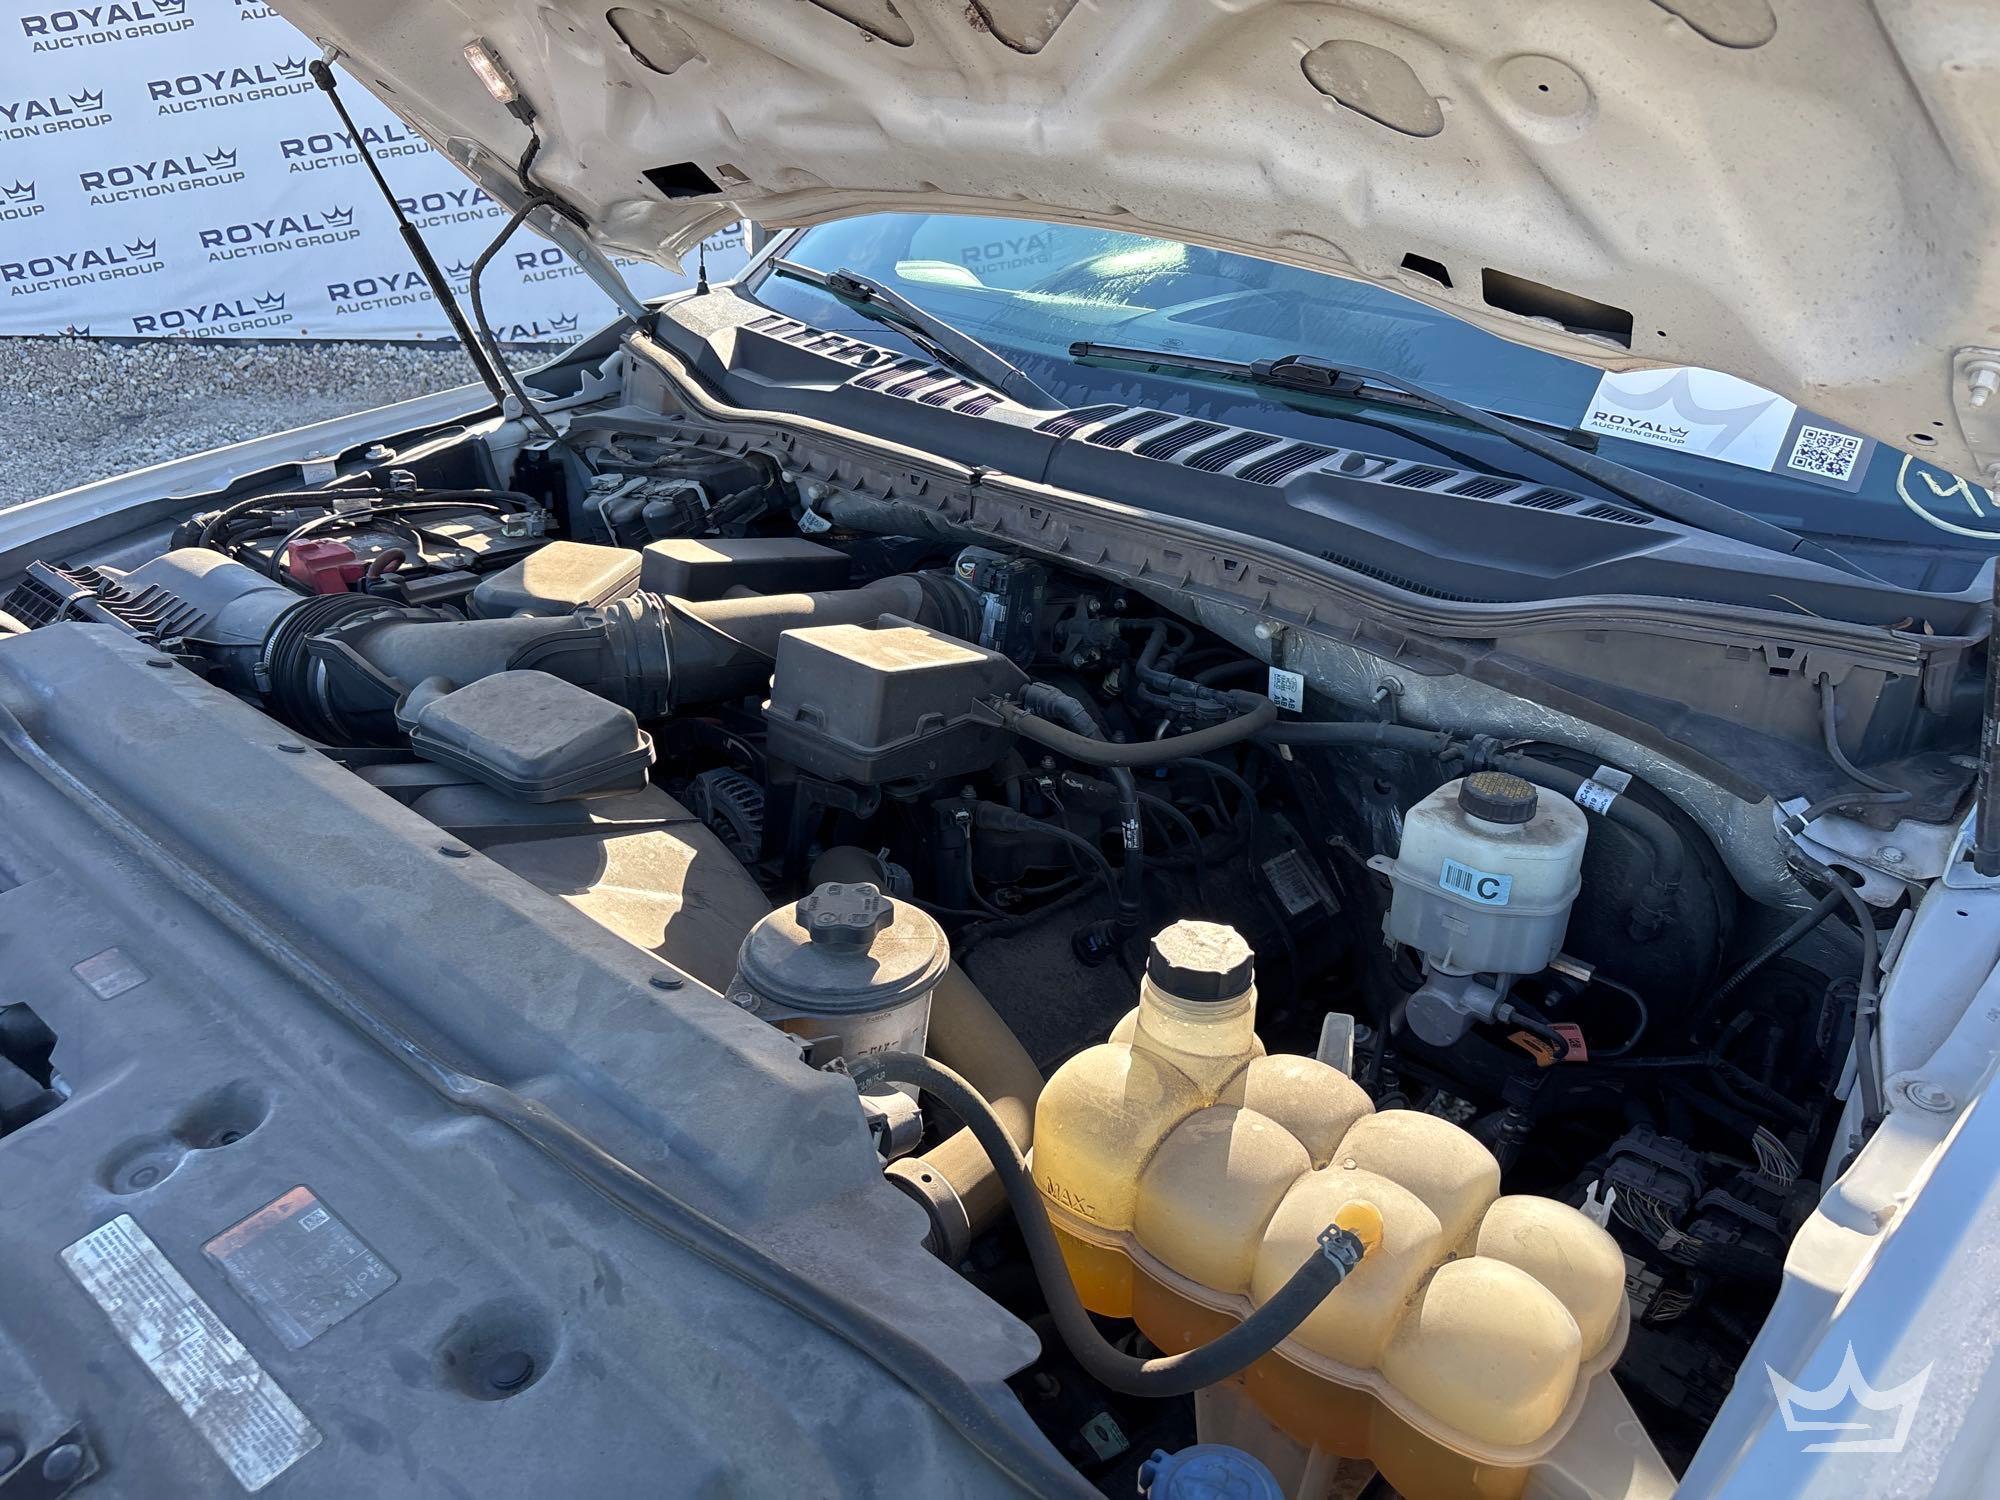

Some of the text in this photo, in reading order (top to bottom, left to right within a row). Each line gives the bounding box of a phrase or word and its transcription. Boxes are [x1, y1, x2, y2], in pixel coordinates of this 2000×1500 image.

[20, 1, 155, 37] ROYAL
[33, 18, 195, 53] AUCTION GROUP
[147, 65, 277, 101] ROYAL
[0, 98, 73, 123] YAL
[157, 81, 315, 116] AUCTION GROUP
[43, 114, 112, 134] GROUP
[377, 143, 436, 160] GROU
[79, 156, 207, 192] ROYAL
[90, 171, 246, 206] AUCTION GROUP
[397, 187, 495, 215] ROYA
[198, 214, 324, 249] ROYAL
[415, 209, 484, 229] UCTION
[208, 229, 361, 263] AUCTION GROUP
[0, 247, 127, 282] ROYAL
[11, 261, 165, 296] AUCTION GROUP
[523, 265, 585, 284] AUCTIO
[327, 271, 427, 301] ROYA
[132, 300, 256, 334] ROYAL
[335, 294, 415, 315] AUCTION
[228, 313, 293, 333] GROUP
[1590, 420, 1685, 445] AUCTION GROUP
[1593, 411, 1667, 434] ROYAL
[1477, 877, 1500, 900] C
